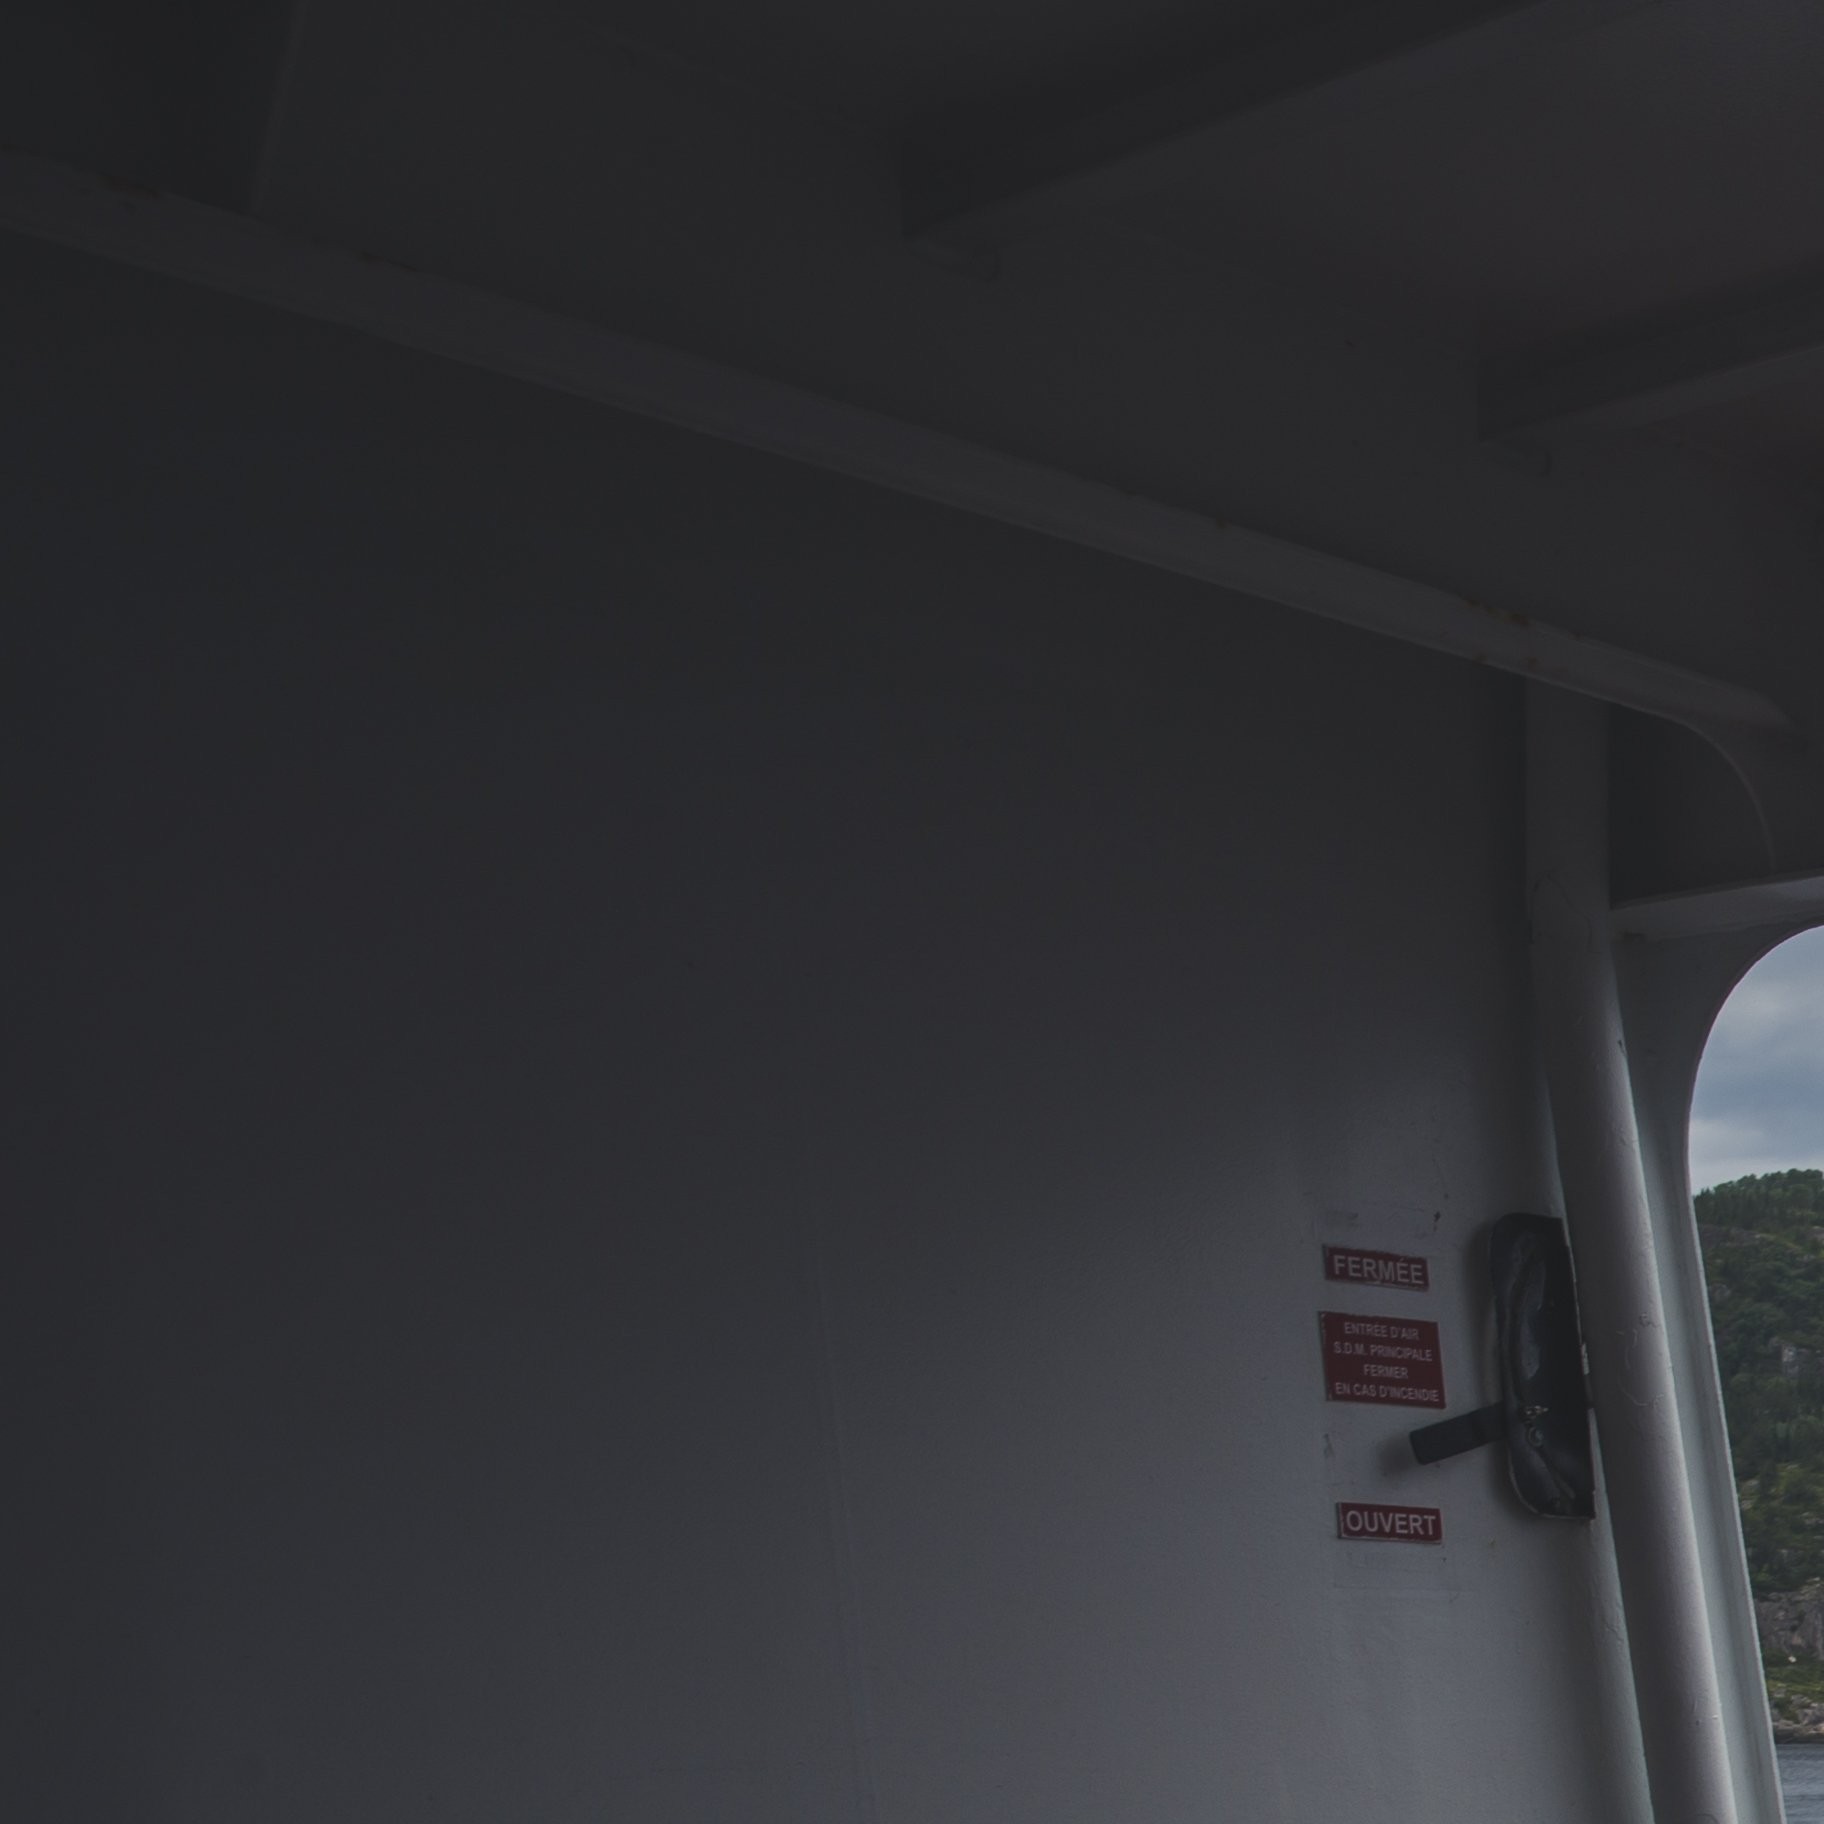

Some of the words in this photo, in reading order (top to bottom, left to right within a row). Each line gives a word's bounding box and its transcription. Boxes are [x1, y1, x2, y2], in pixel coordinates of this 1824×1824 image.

[1333, 1254, 1424, 1285] FERMÉE
[1343, 1321, 1388, 1338] ENTRÉE
[1390, 1326, 1419, 1341] D'AIR
[1369, 1344, 1433, 1362] PRINCIPALE
[1363, 1363, 1409, 1380] FERMER
[1335, 1381, 1351, 1395] EN
[1353, 1383, 1377, 1397] CAS
[1379, 1385, 1440, 1402] D'INCENDIE
[1346, 1510, 1436, 1535] OUVERT
